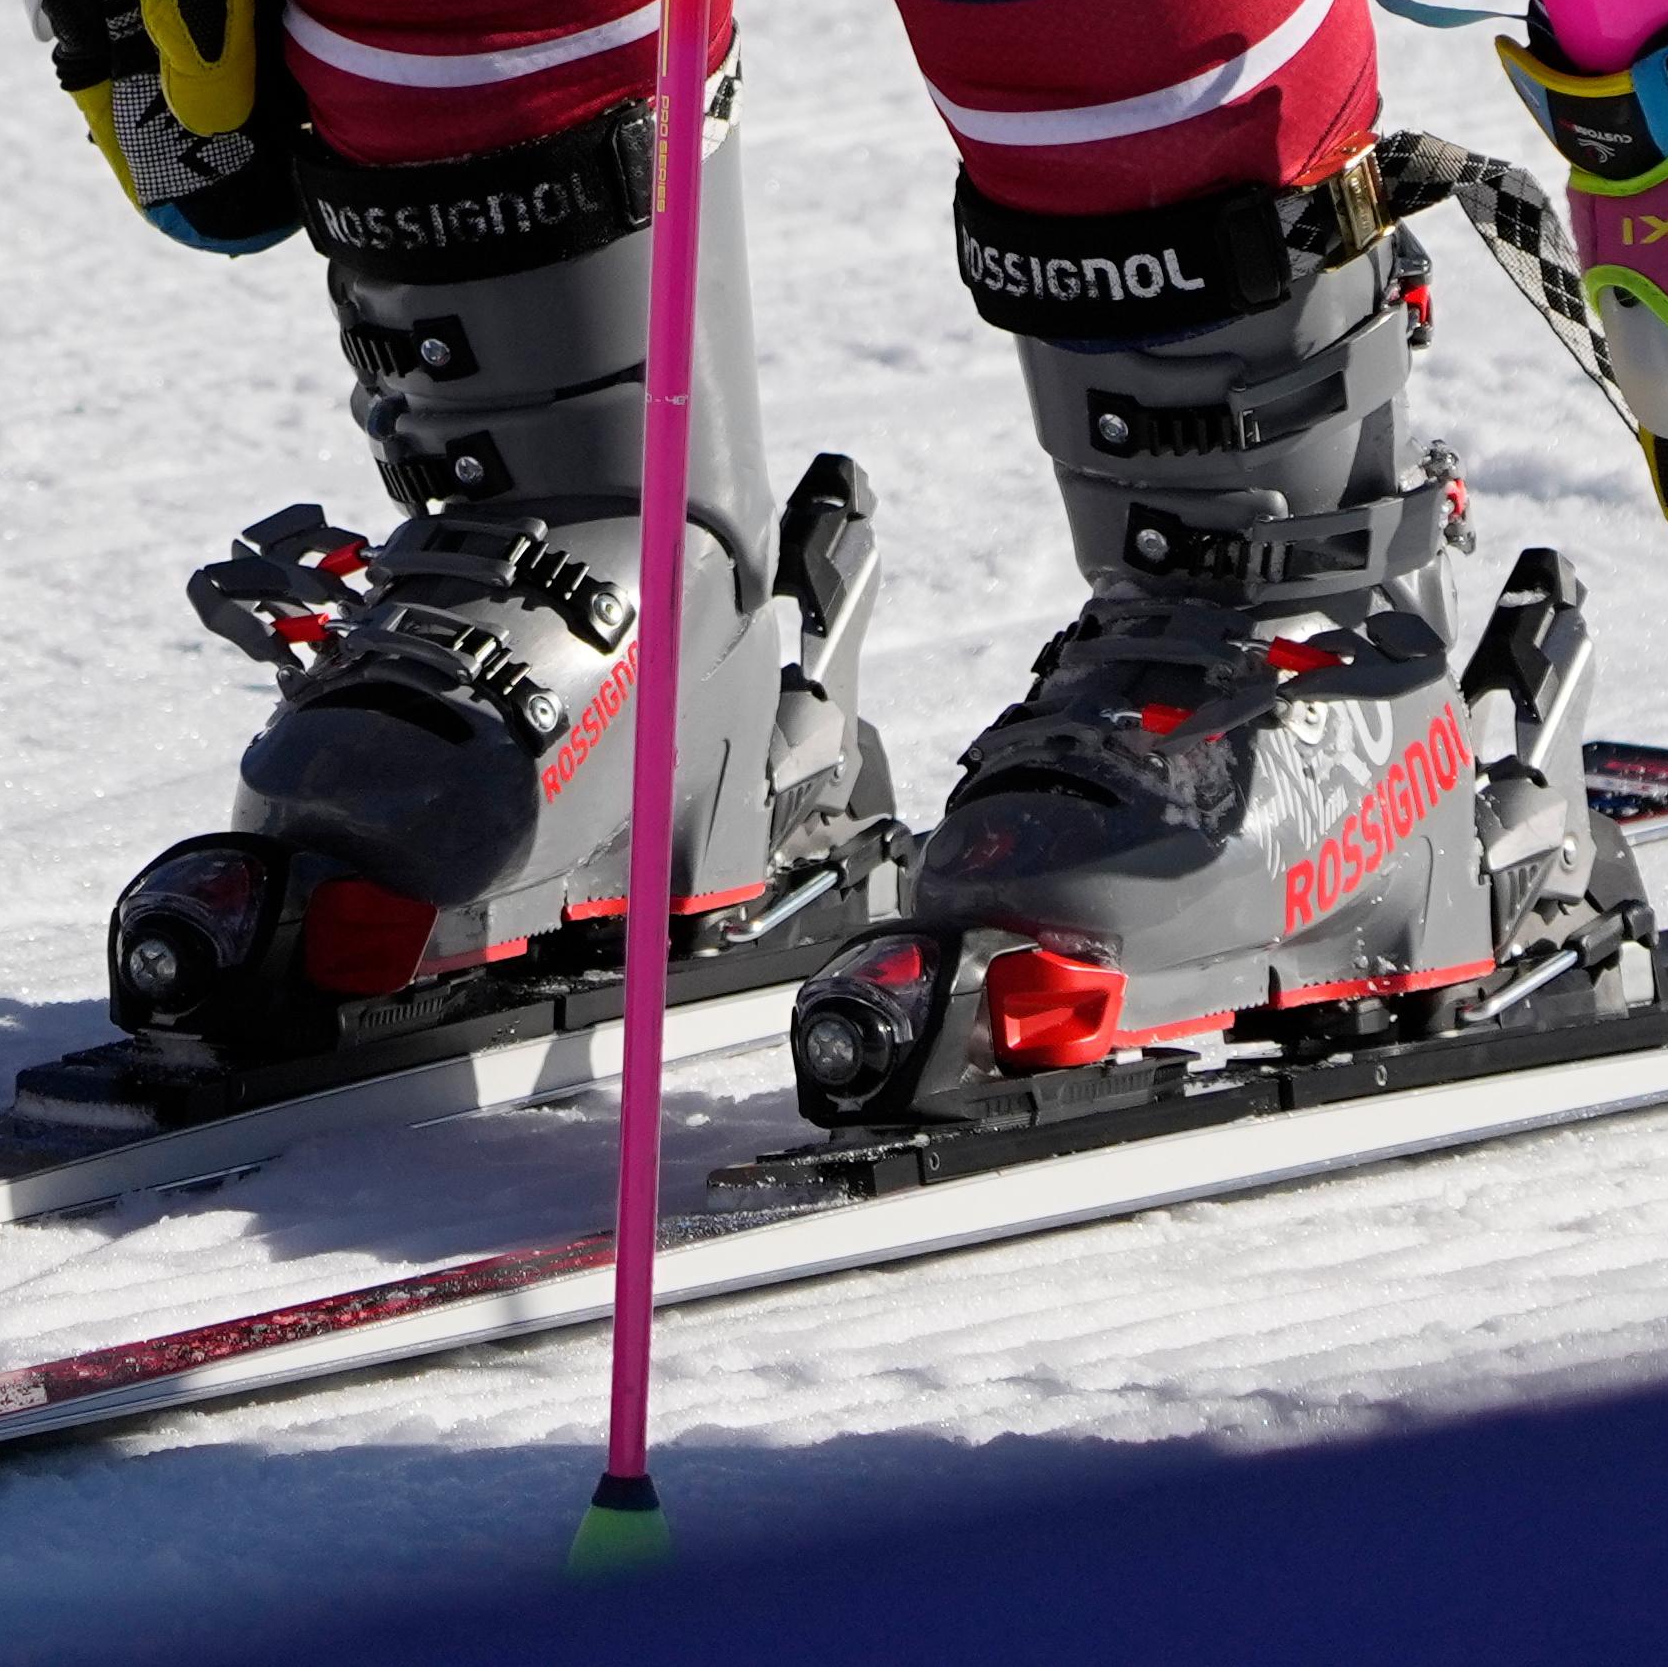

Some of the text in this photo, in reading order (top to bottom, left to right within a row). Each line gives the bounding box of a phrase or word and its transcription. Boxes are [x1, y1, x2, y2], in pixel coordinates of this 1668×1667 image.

[318, 173, 600, 249] ROSSIGNOL
[657, 95, 670, 213] PRO SERIES
[1284, 701, 1471, 937] ROSSIGNOL
